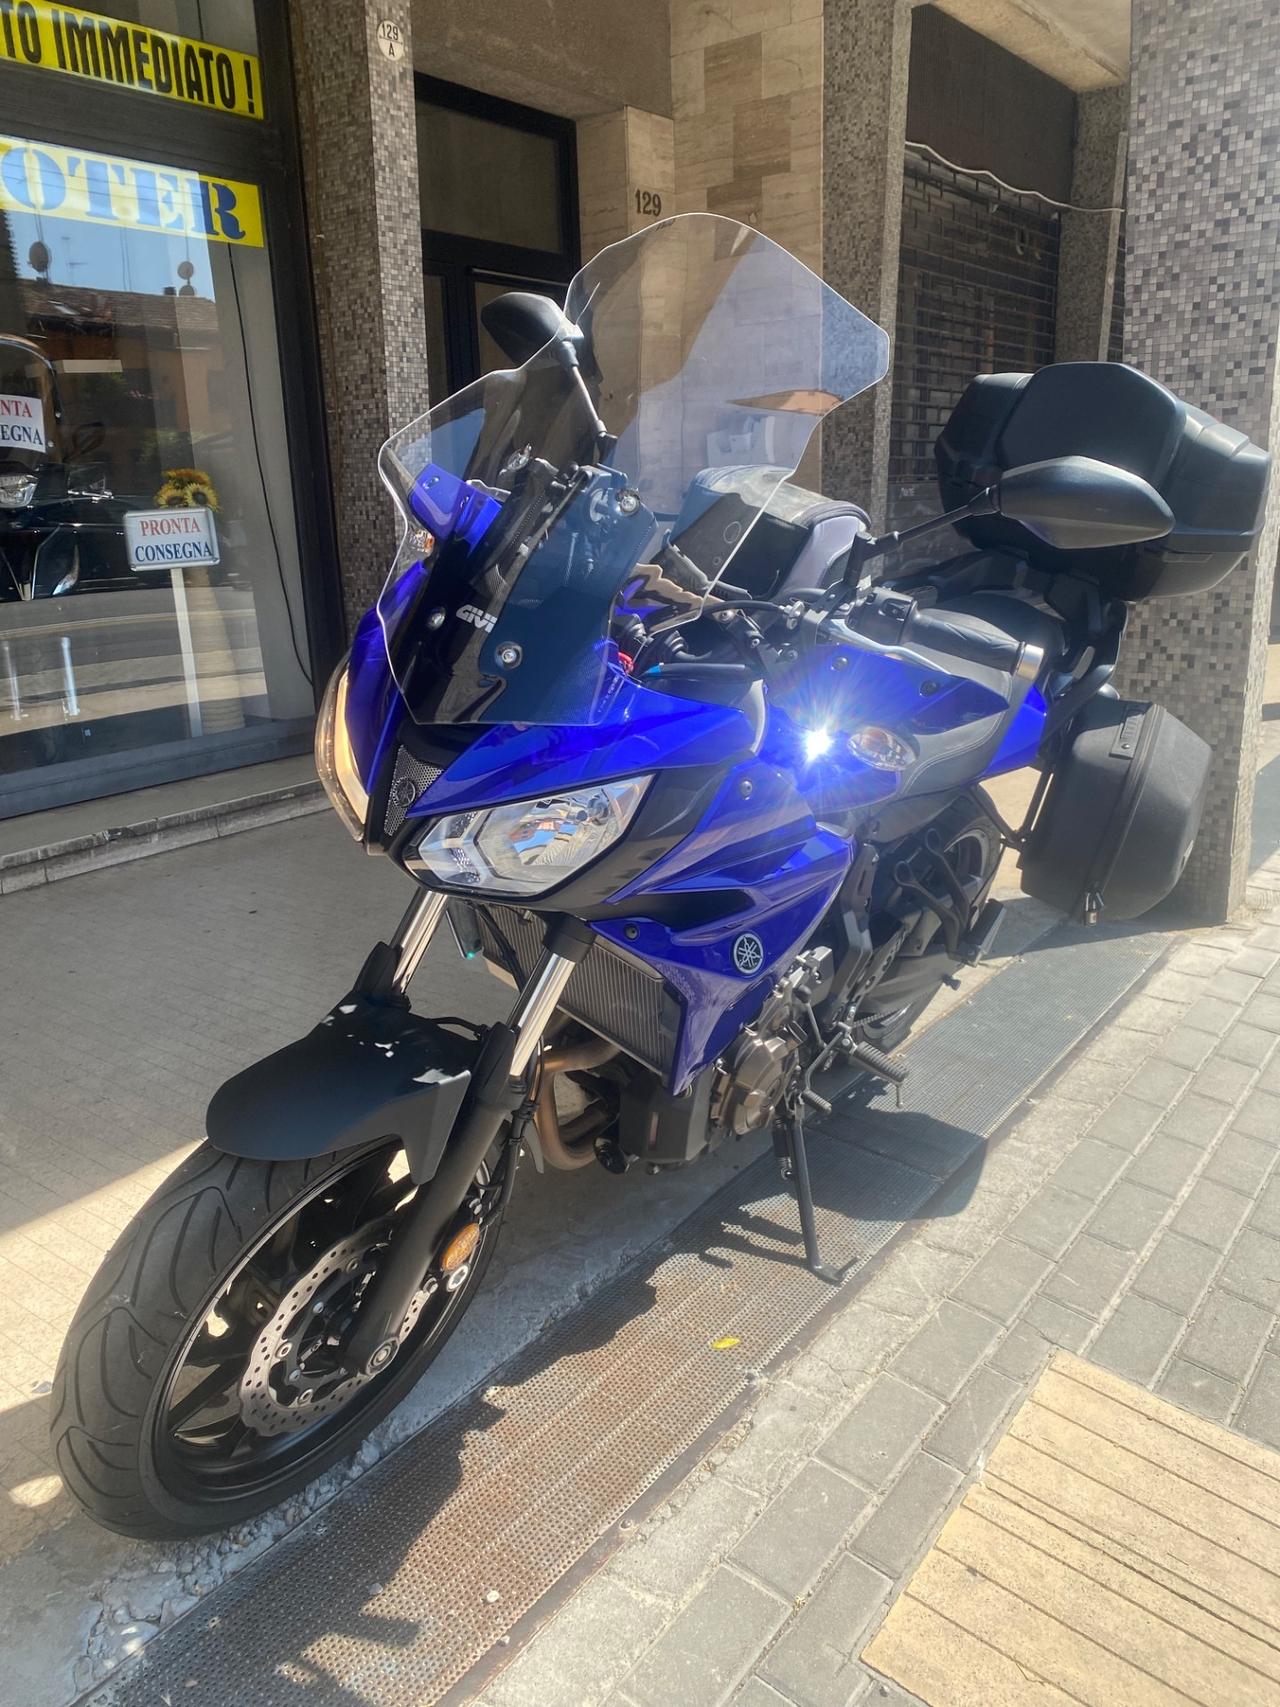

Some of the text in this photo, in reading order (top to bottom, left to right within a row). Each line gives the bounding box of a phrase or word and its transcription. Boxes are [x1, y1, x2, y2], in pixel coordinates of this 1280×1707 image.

[382, 22, 399, 41] 129
[388, 42, 396, 58] A
[0, 147, 246, 240] OTER
[635, 188, 662, 217] 129
[0, 424, 44, 446] EGNA
[140, 517, 201, 537] PRONTA
[134, 541, 214, 562] CONSEGNA
[456, 604, 498, 633] GIVI
